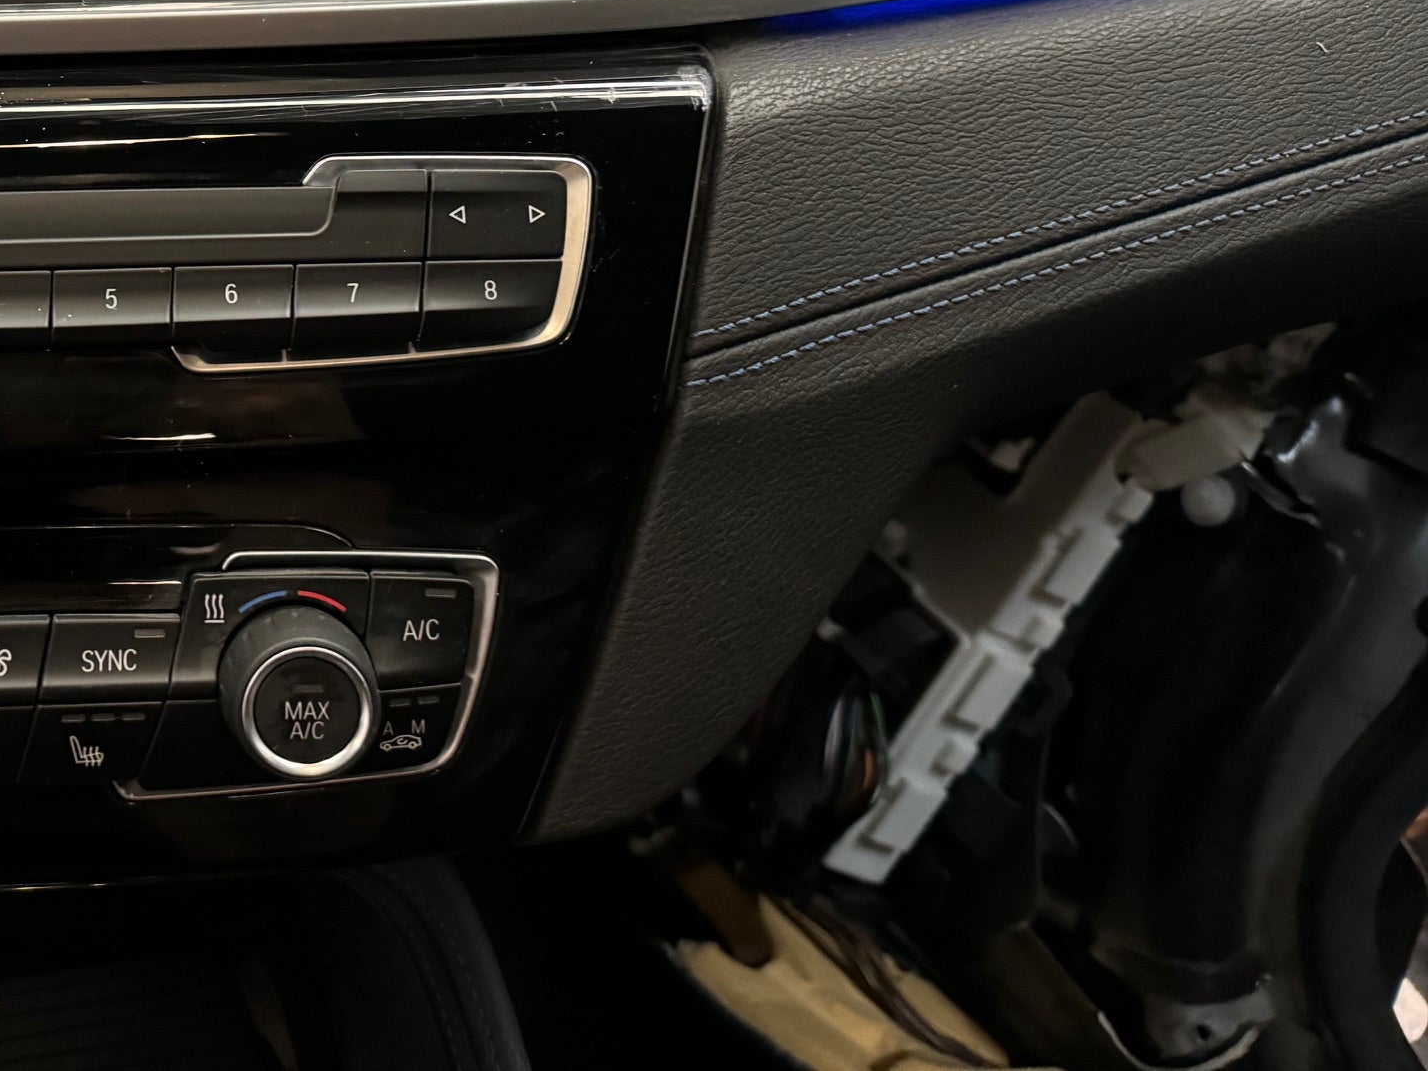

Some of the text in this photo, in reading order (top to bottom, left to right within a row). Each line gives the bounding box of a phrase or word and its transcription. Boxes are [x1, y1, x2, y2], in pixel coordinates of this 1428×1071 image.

[105, 288, 118, 310] 5
[225, 283, 239, 305] 6
[347, 282, 359, 304] 7
[484, 279, 498, 301] 8
[402, 618, 440, 641] A/C
[81, 648, 137, 673] SYNC
[284, 700, 330, 721] MAX
[289, 721, 325, 740] A/C
[383, 719, 426, 736] A M
